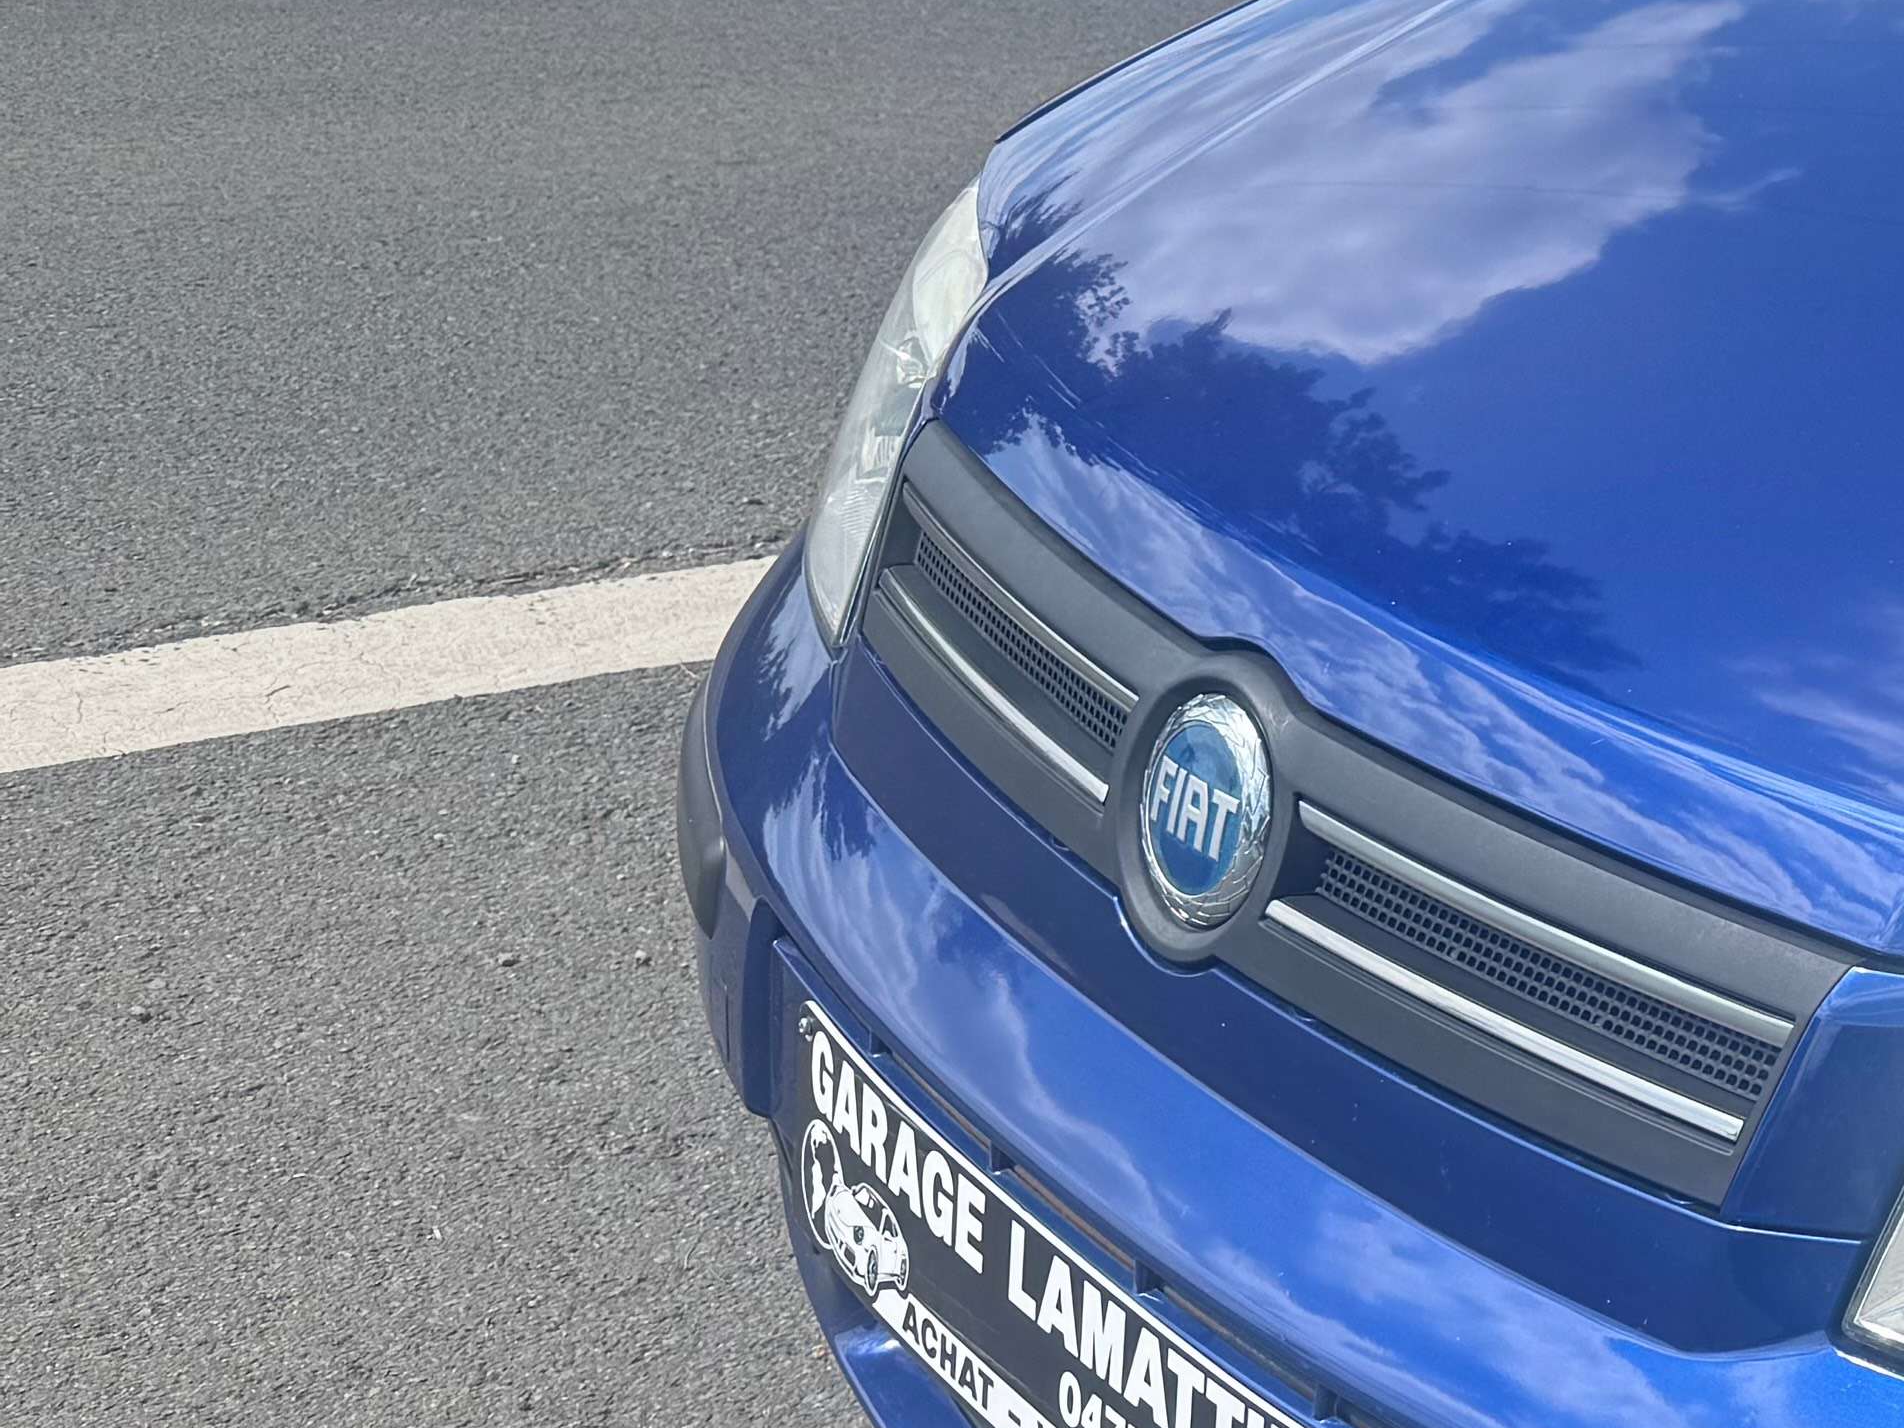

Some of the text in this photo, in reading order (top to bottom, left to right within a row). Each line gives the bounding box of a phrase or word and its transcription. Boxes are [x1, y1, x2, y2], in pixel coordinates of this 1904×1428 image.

[1151, 755, 1241, 863] FIAT
[811, 1030, 986, 1275] GARAGE
[901, 1303, 996, 1415] ACHAT
